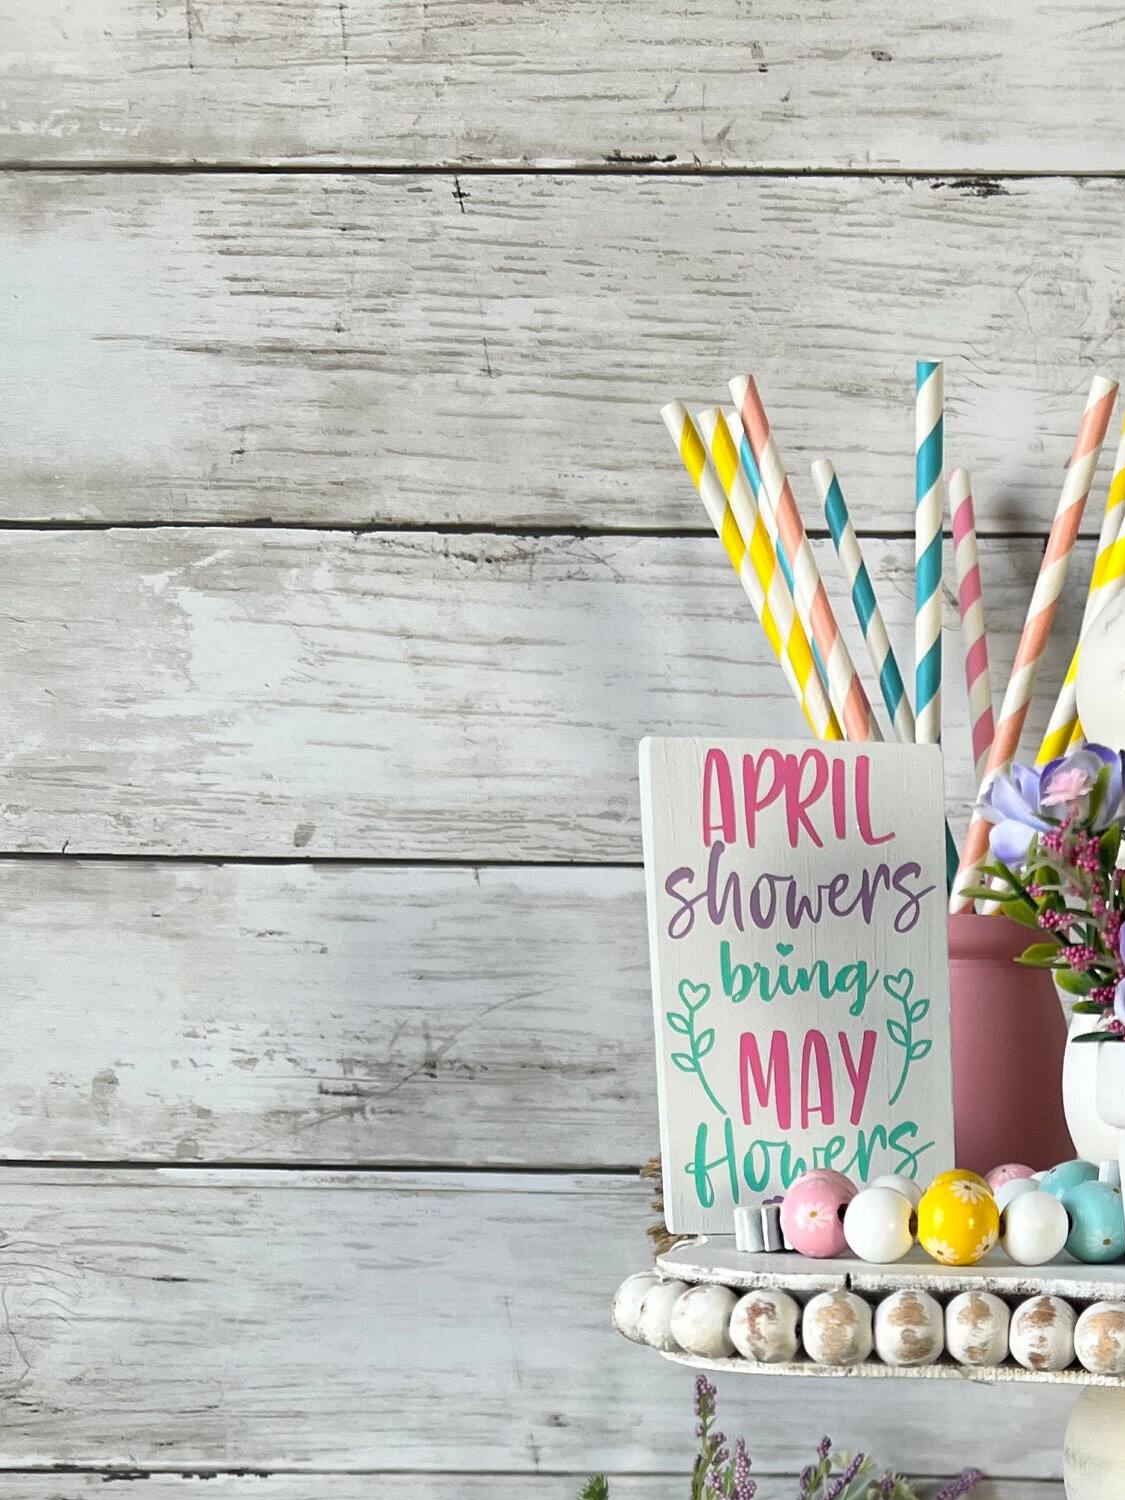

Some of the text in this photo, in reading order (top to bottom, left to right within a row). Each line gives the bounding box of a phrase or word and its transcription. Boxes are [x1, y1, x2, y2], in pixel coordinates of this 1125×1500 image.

[701, 747, 896, 849] APRIL
[664, 840, 936, 940] showers
[719, 940, 879, 1018] bring
[738, 1029, 878, 1131] MAY
